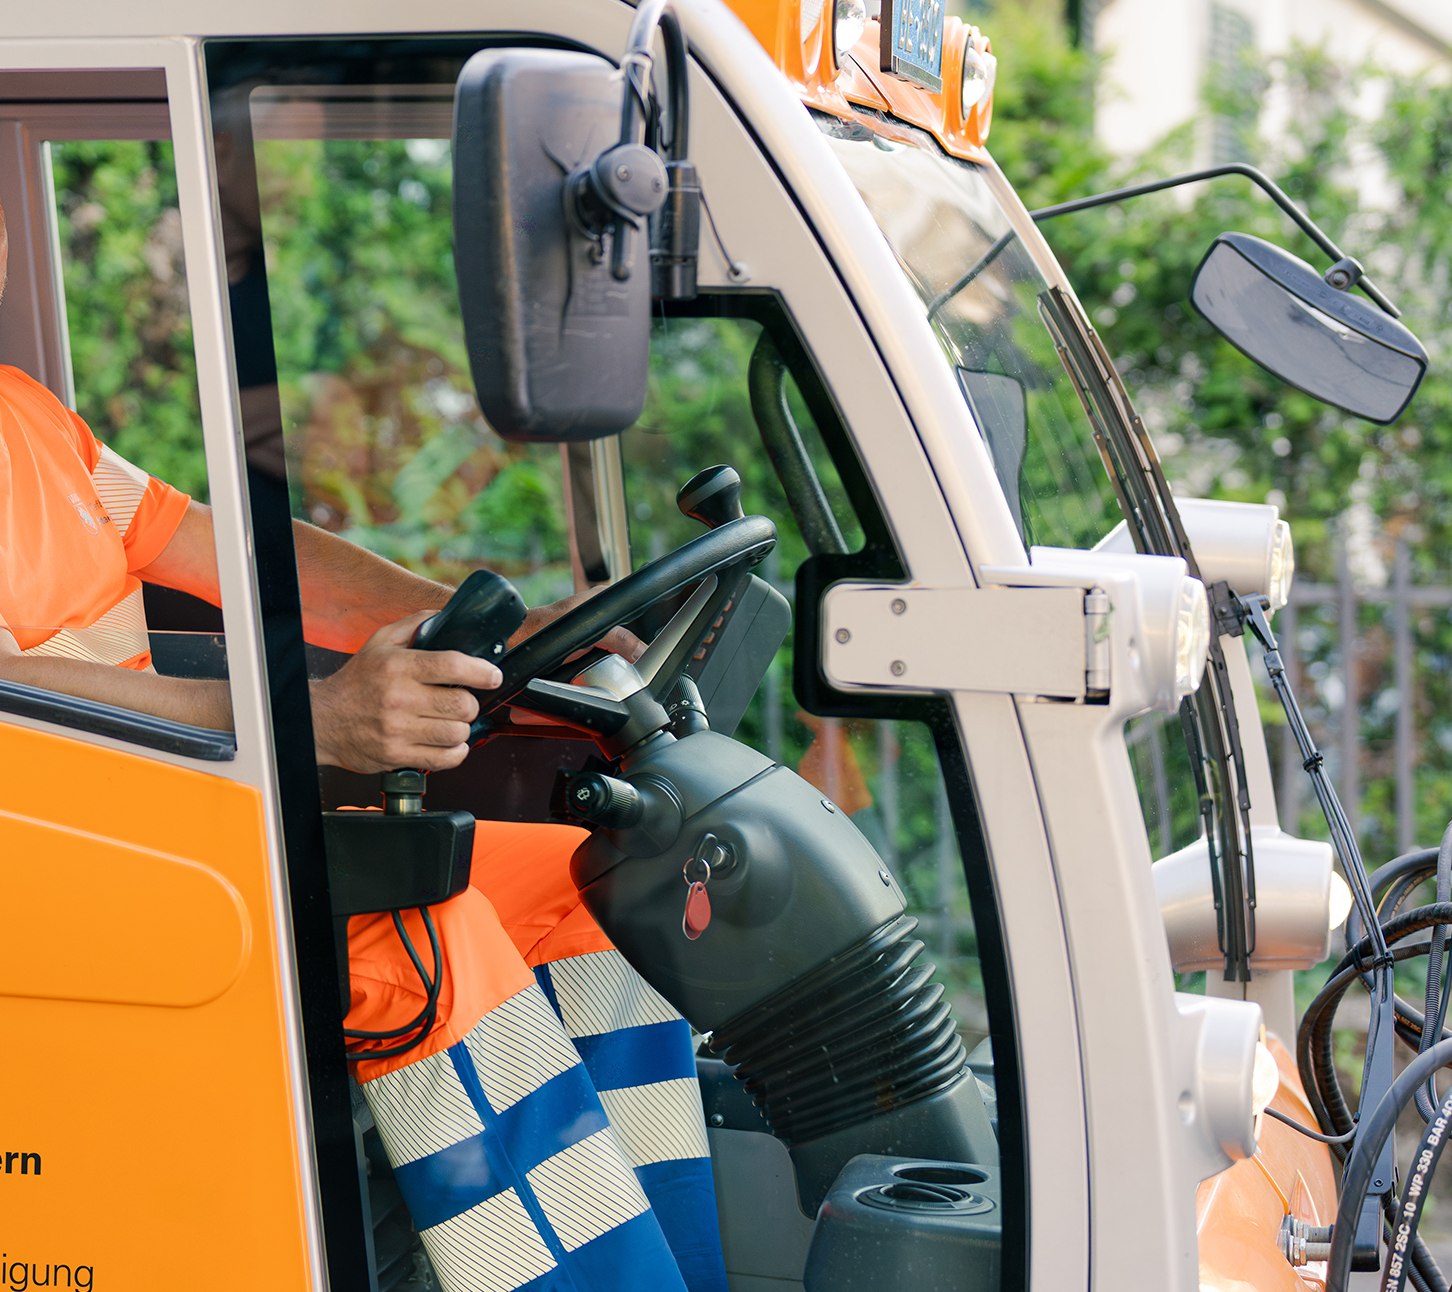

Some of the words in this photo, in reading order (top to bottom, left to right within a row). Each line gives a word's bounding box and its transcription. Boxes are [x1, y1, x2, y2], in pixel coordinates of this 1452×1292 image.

[1427, 1117, 1448, 1147] BAR
[1416, 1149, 1434, 1174] 330
[1408, 1173, 1424, 1197] WP
[1403, 1201, 1417, 1218] 10
[1395, 1223, 1411, 1253] 2SC
[1389, 1252, 1404, 1278] 857
